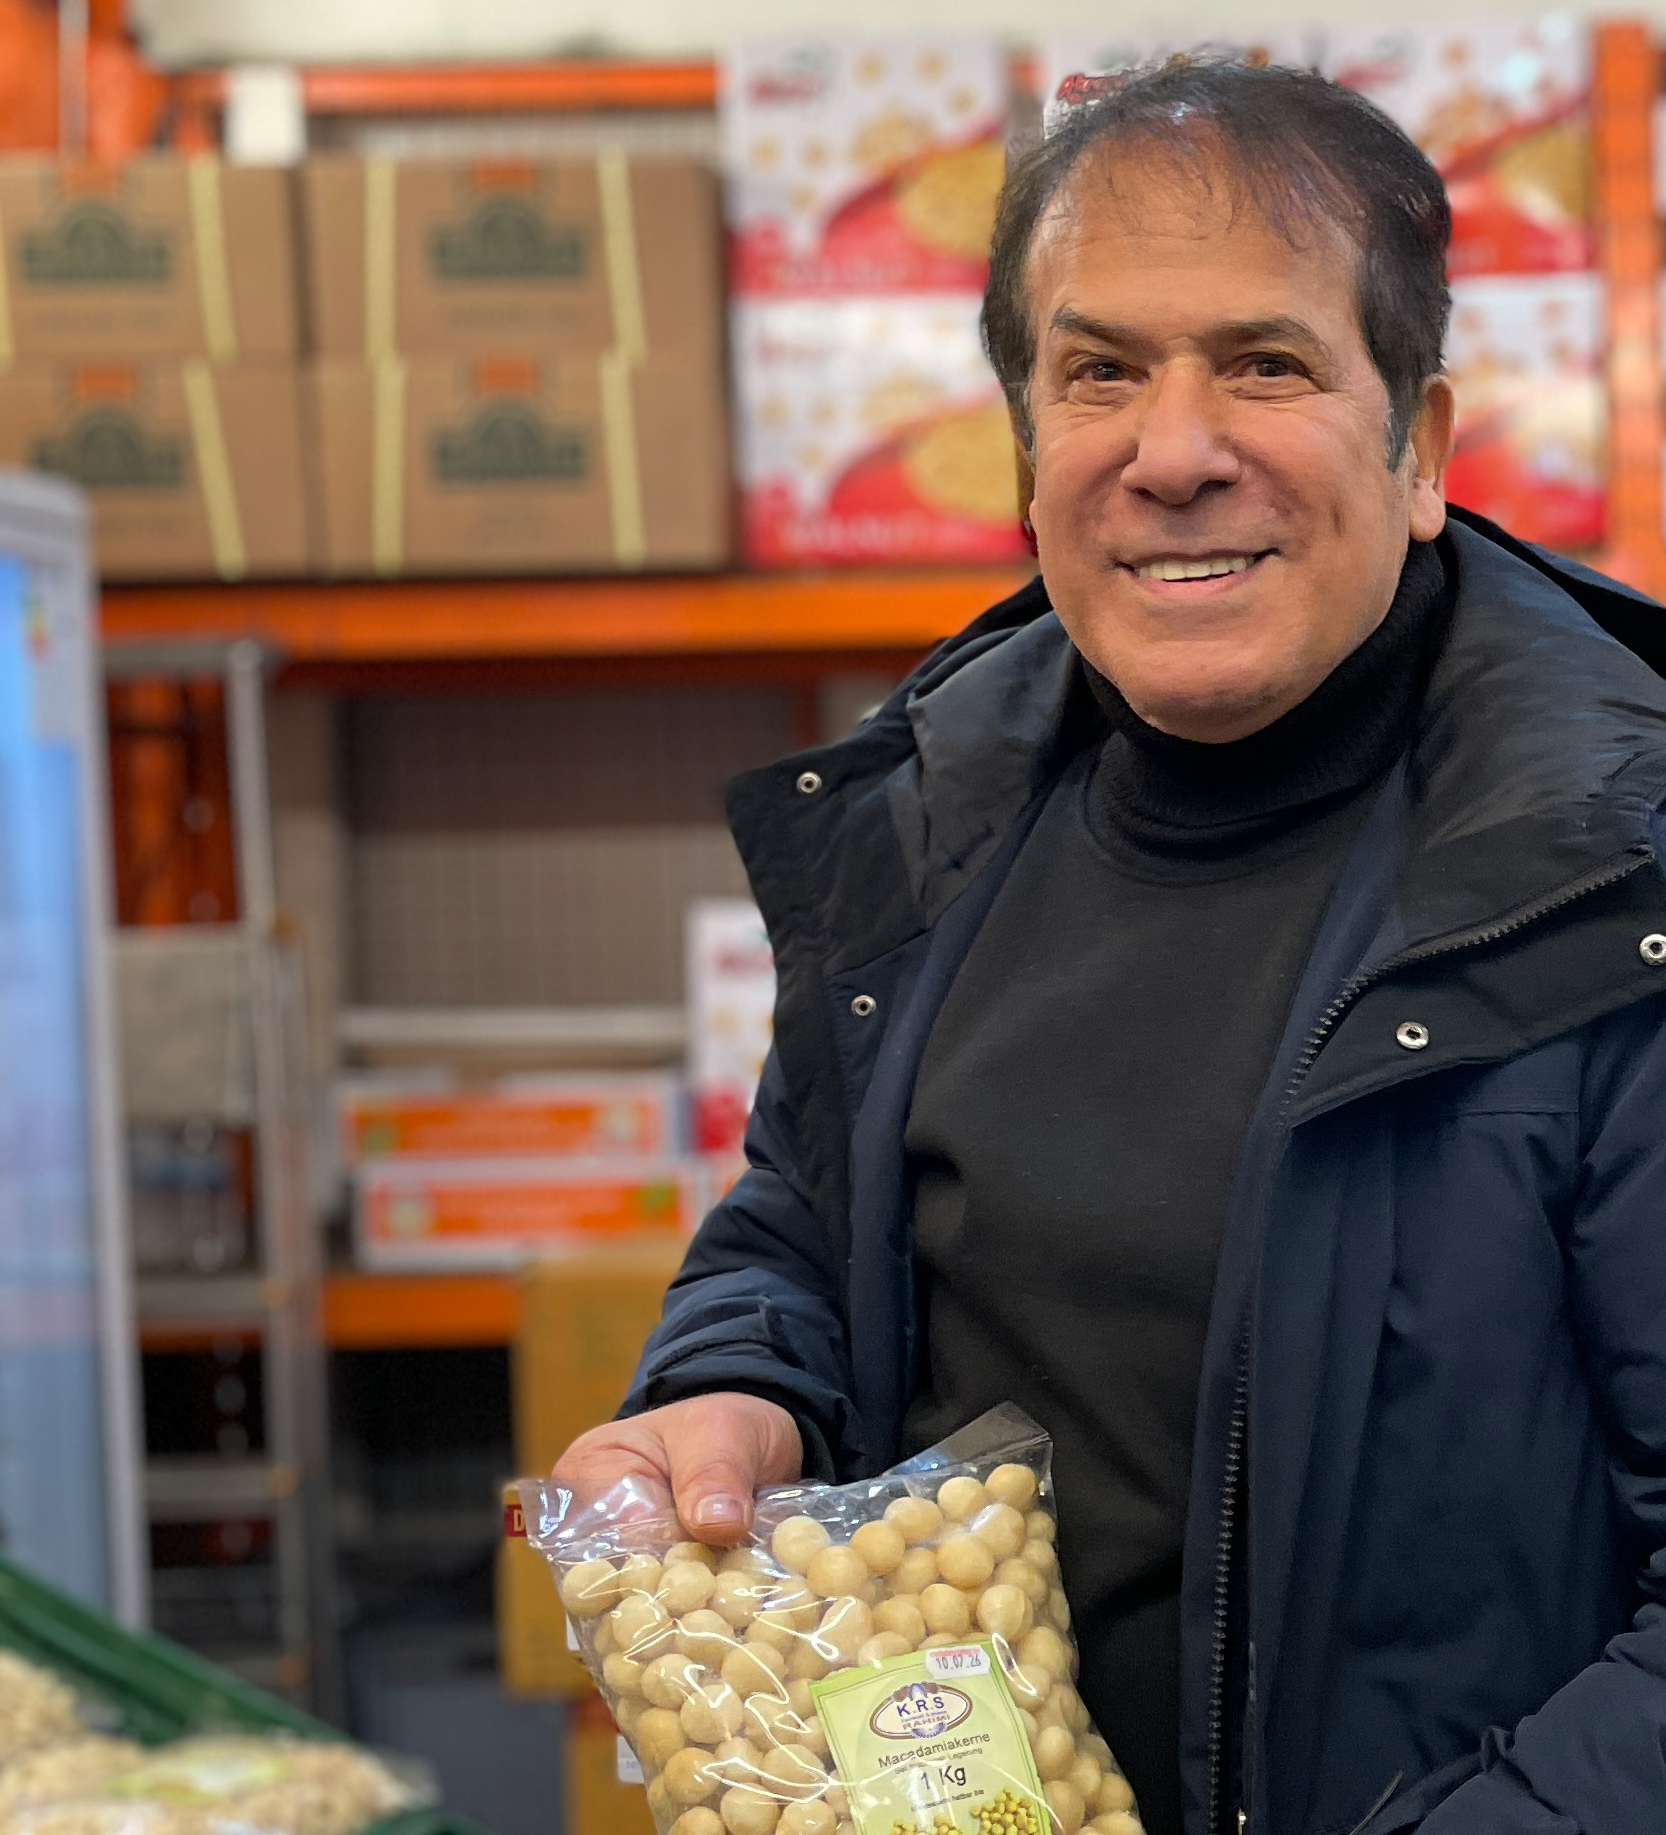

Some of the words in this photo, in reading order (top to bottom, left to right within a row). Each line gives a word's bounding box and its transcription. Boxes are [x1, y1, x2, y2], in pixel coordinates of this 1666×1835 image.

[877, 1733, 991, 1768] Macadamiakerne
[920, 1772, 931, 1790] 1
[938, 1764, 967, 1786] Kg
